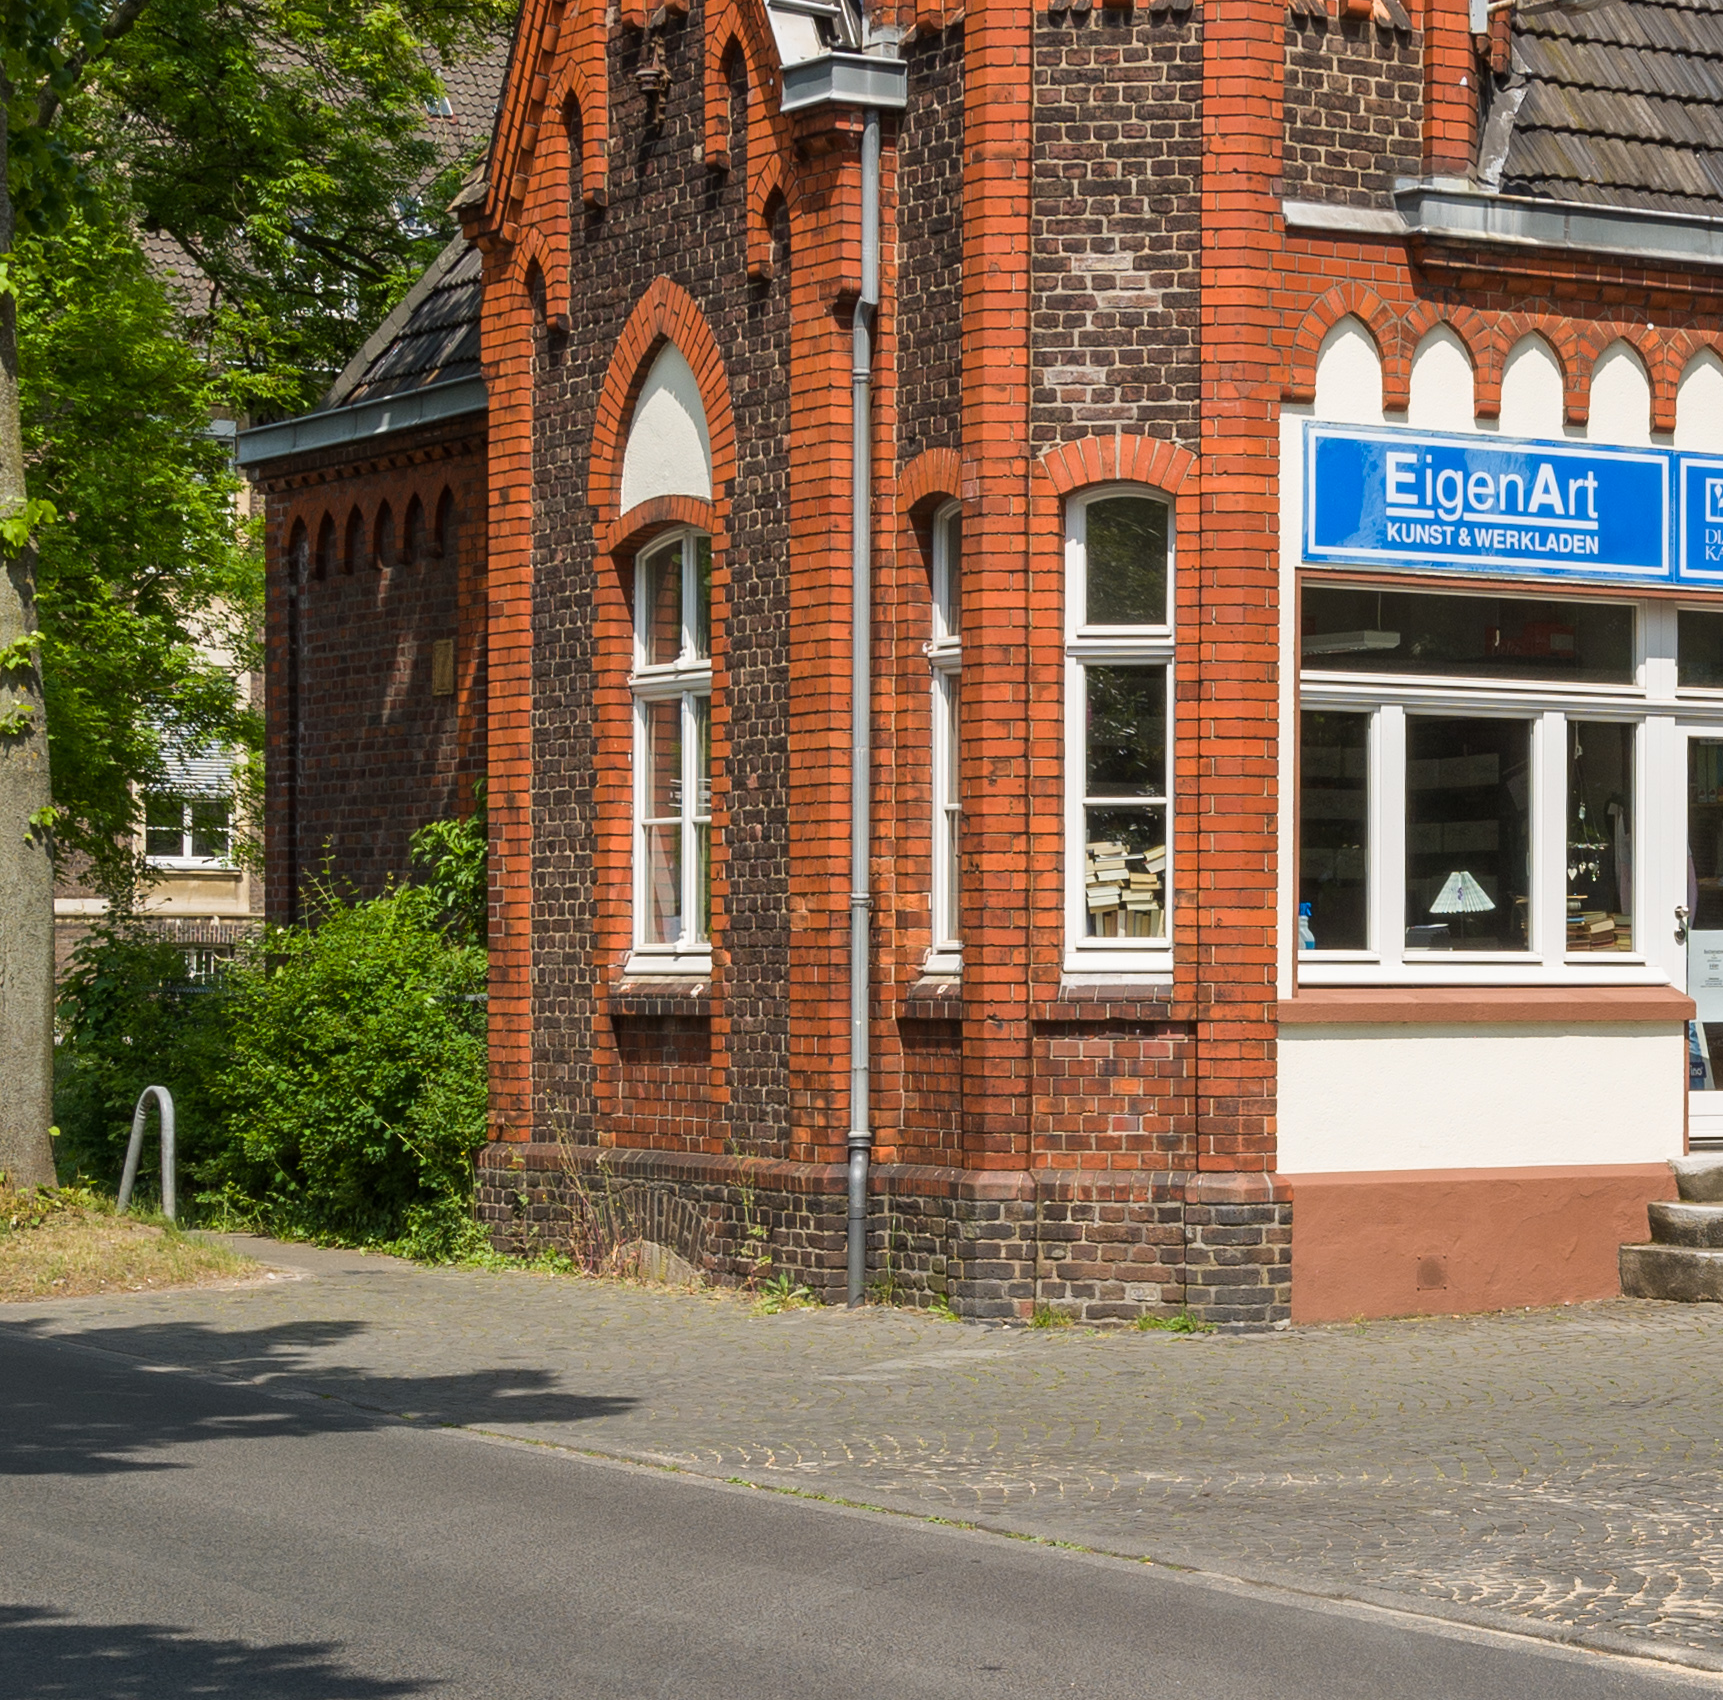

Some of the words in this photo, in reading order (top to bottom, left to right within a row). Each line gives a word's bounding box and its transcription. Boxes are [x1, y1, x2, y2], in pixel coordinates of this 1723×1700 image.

[1386, 451, 1598, 522] EigenArt
[1386, 522, 1455, 546] KUNST
[1458, 527, 1472, 547] &
[1474, 528, 1599, 555] WERKLADEN
